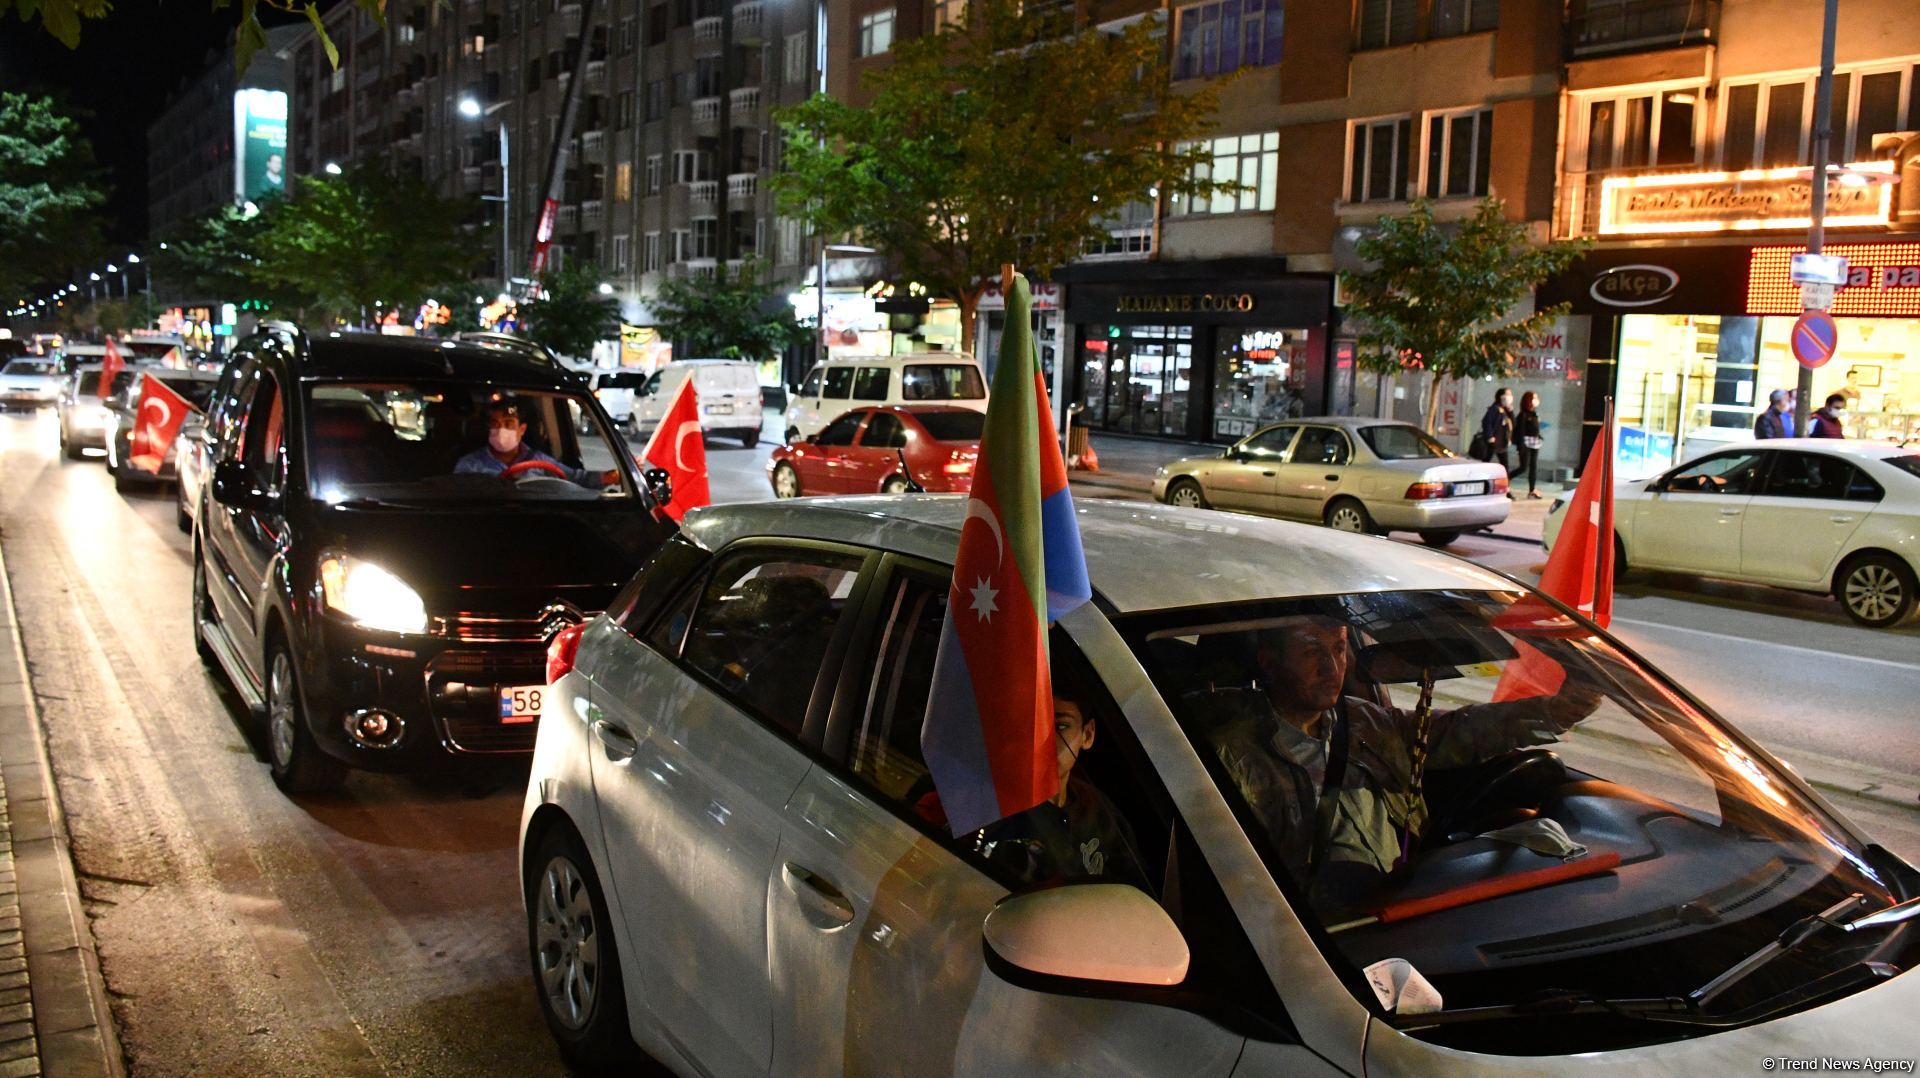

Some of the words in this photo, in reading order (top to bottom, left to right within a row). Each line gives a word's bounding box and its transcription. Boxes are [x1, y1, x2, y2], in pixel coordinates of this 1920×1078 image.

[1605, 272, 1660, 295] akça
[1117, 294, 1194, 312] MADAME
[1200, 293, 1253, 312] COCO
[514, 690, 541, 712] 58
